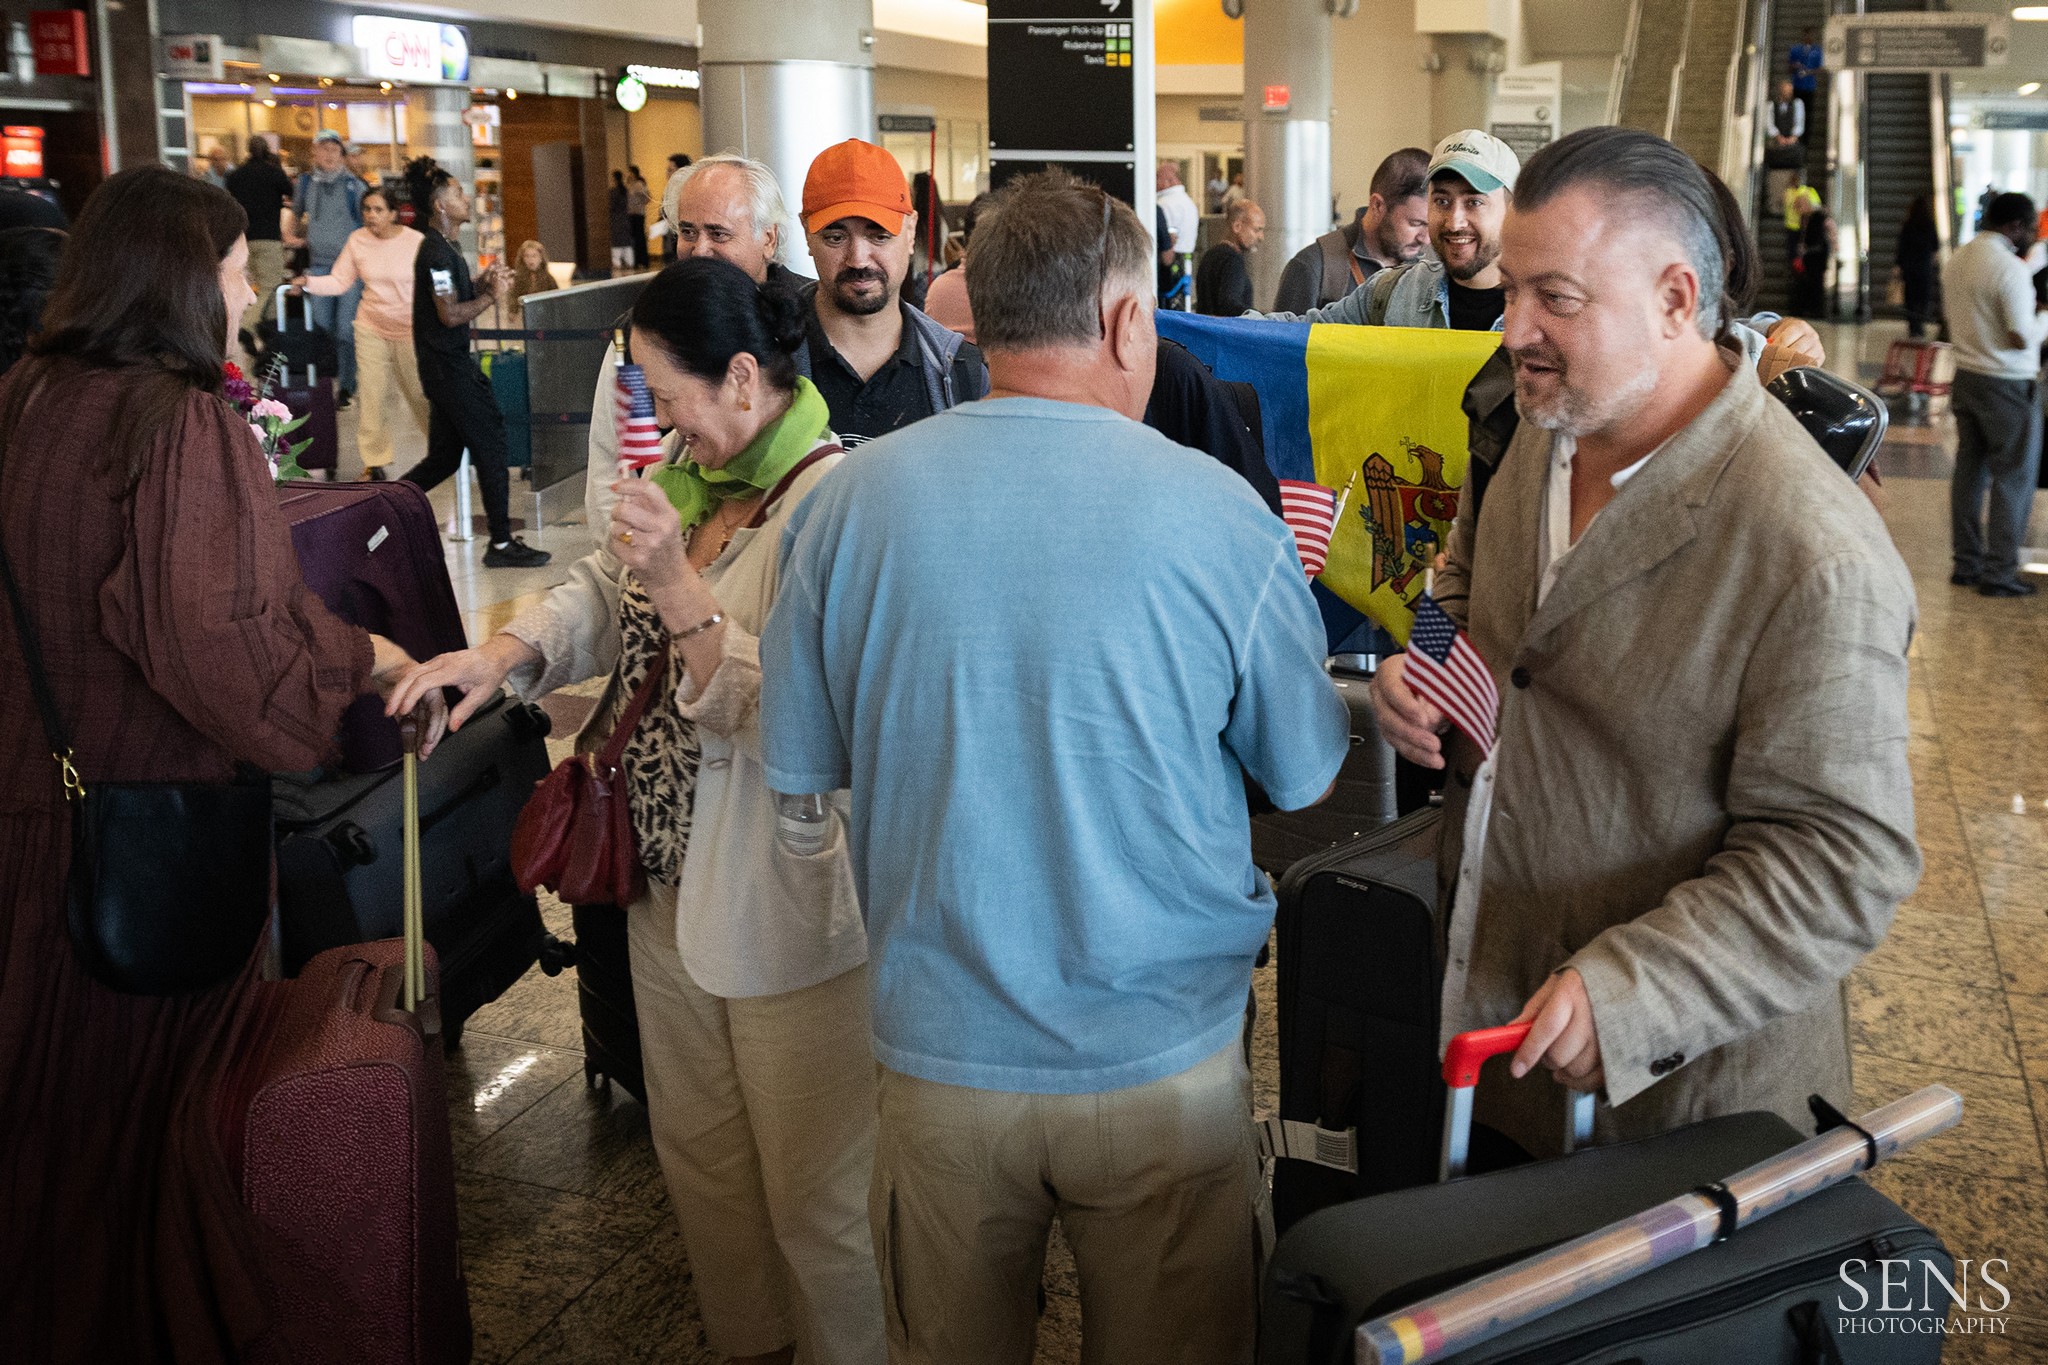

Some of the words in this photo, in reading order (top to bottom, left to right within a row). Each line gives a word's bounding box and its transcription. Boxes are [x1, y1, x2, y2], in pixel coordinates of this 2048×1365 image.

[1027, 25, 1070, 37] Passenger
[1071, 25, 1105, 36] Pick-Up
[385, 31, 431, 69] CNN
[1063, 40, 1105, 51] Rideshare
[1084, 54, 1105, 65] Taxis
[1443, 143, 1480, 155] California
